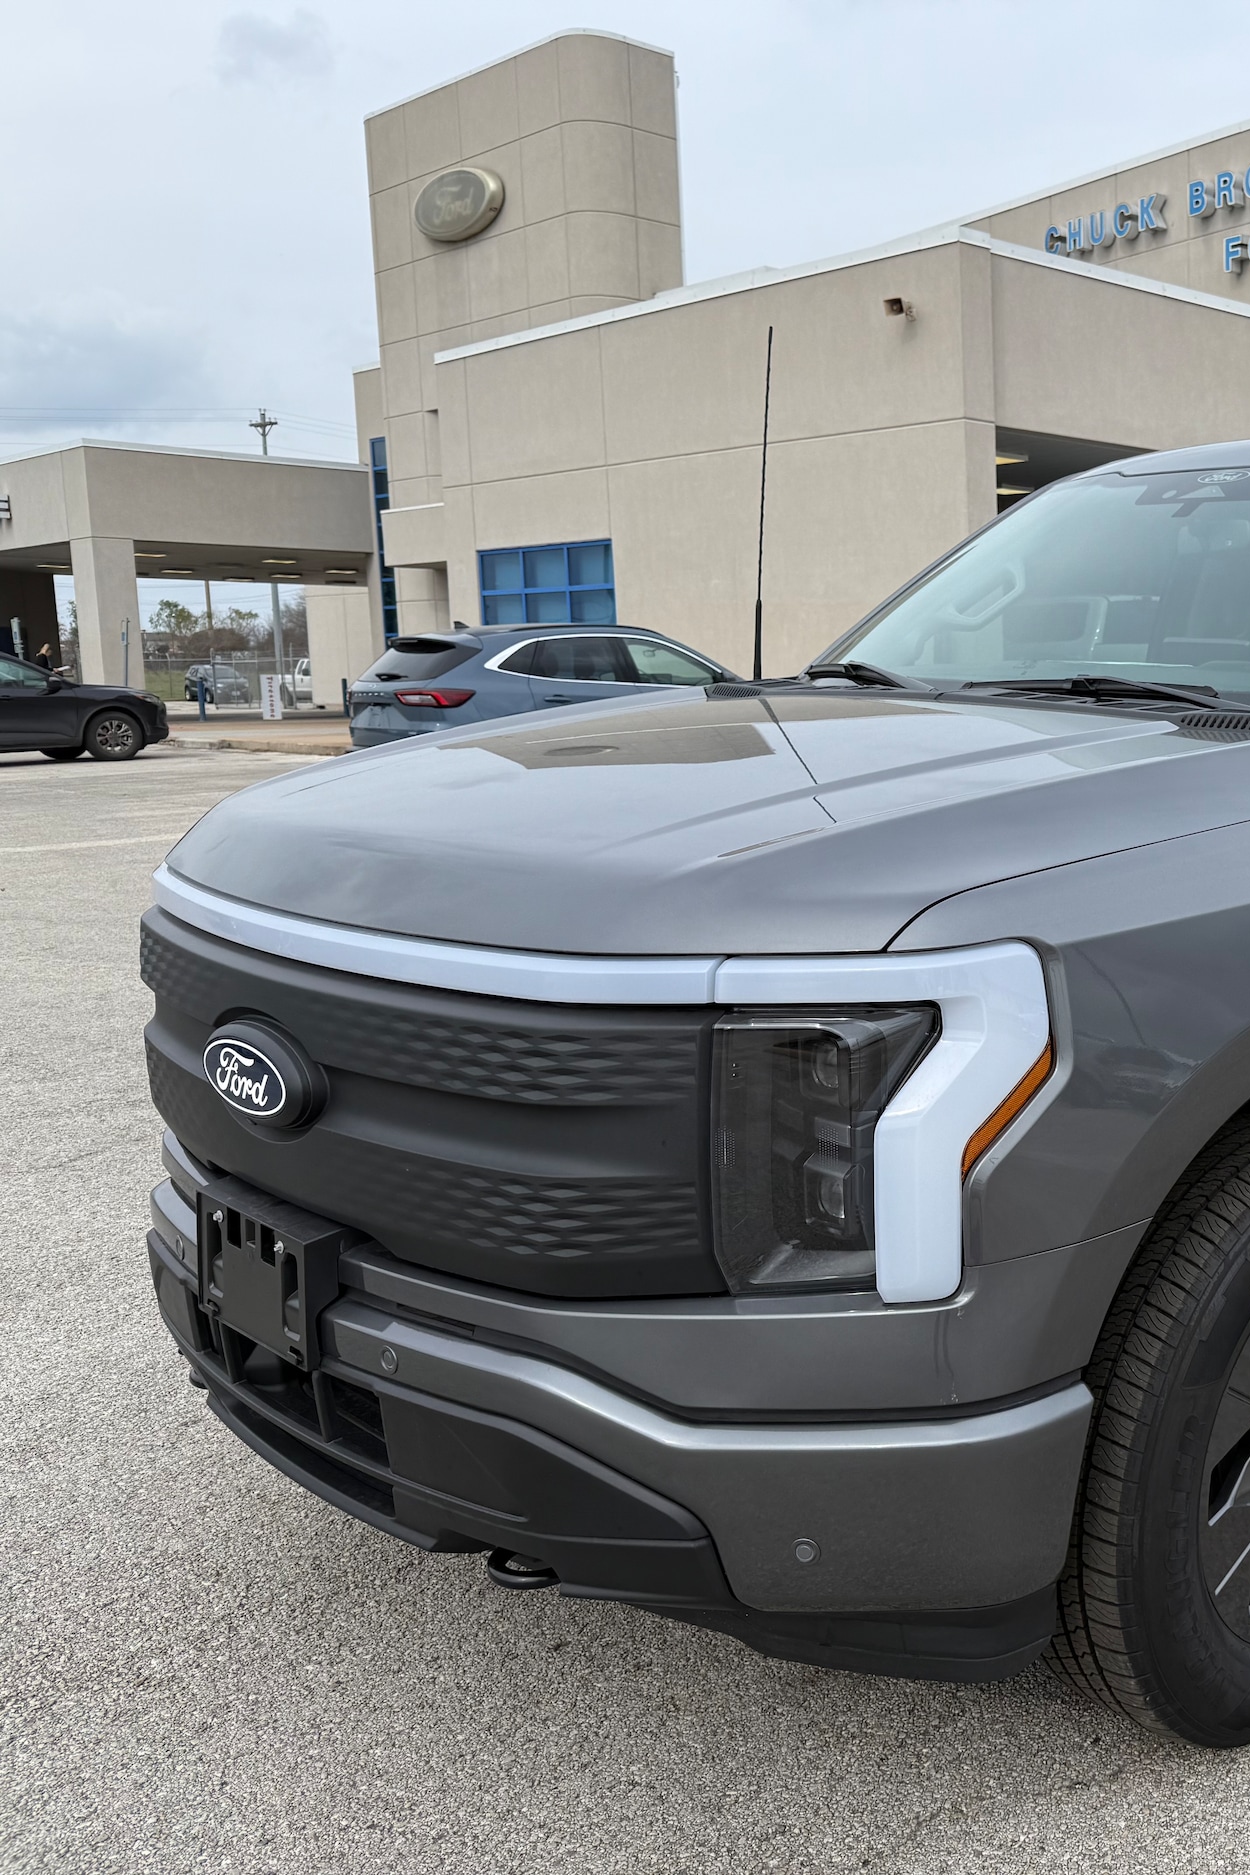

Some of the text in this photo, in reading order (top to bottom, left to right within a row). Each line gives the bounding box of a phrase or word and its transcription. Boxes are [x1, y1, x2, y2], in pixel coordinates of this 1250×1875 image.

[432, 184, 474, 225] Ford
[1043, 192, 1167, 256] CHUCK
[216, 1047, 269, 1107] Ford
